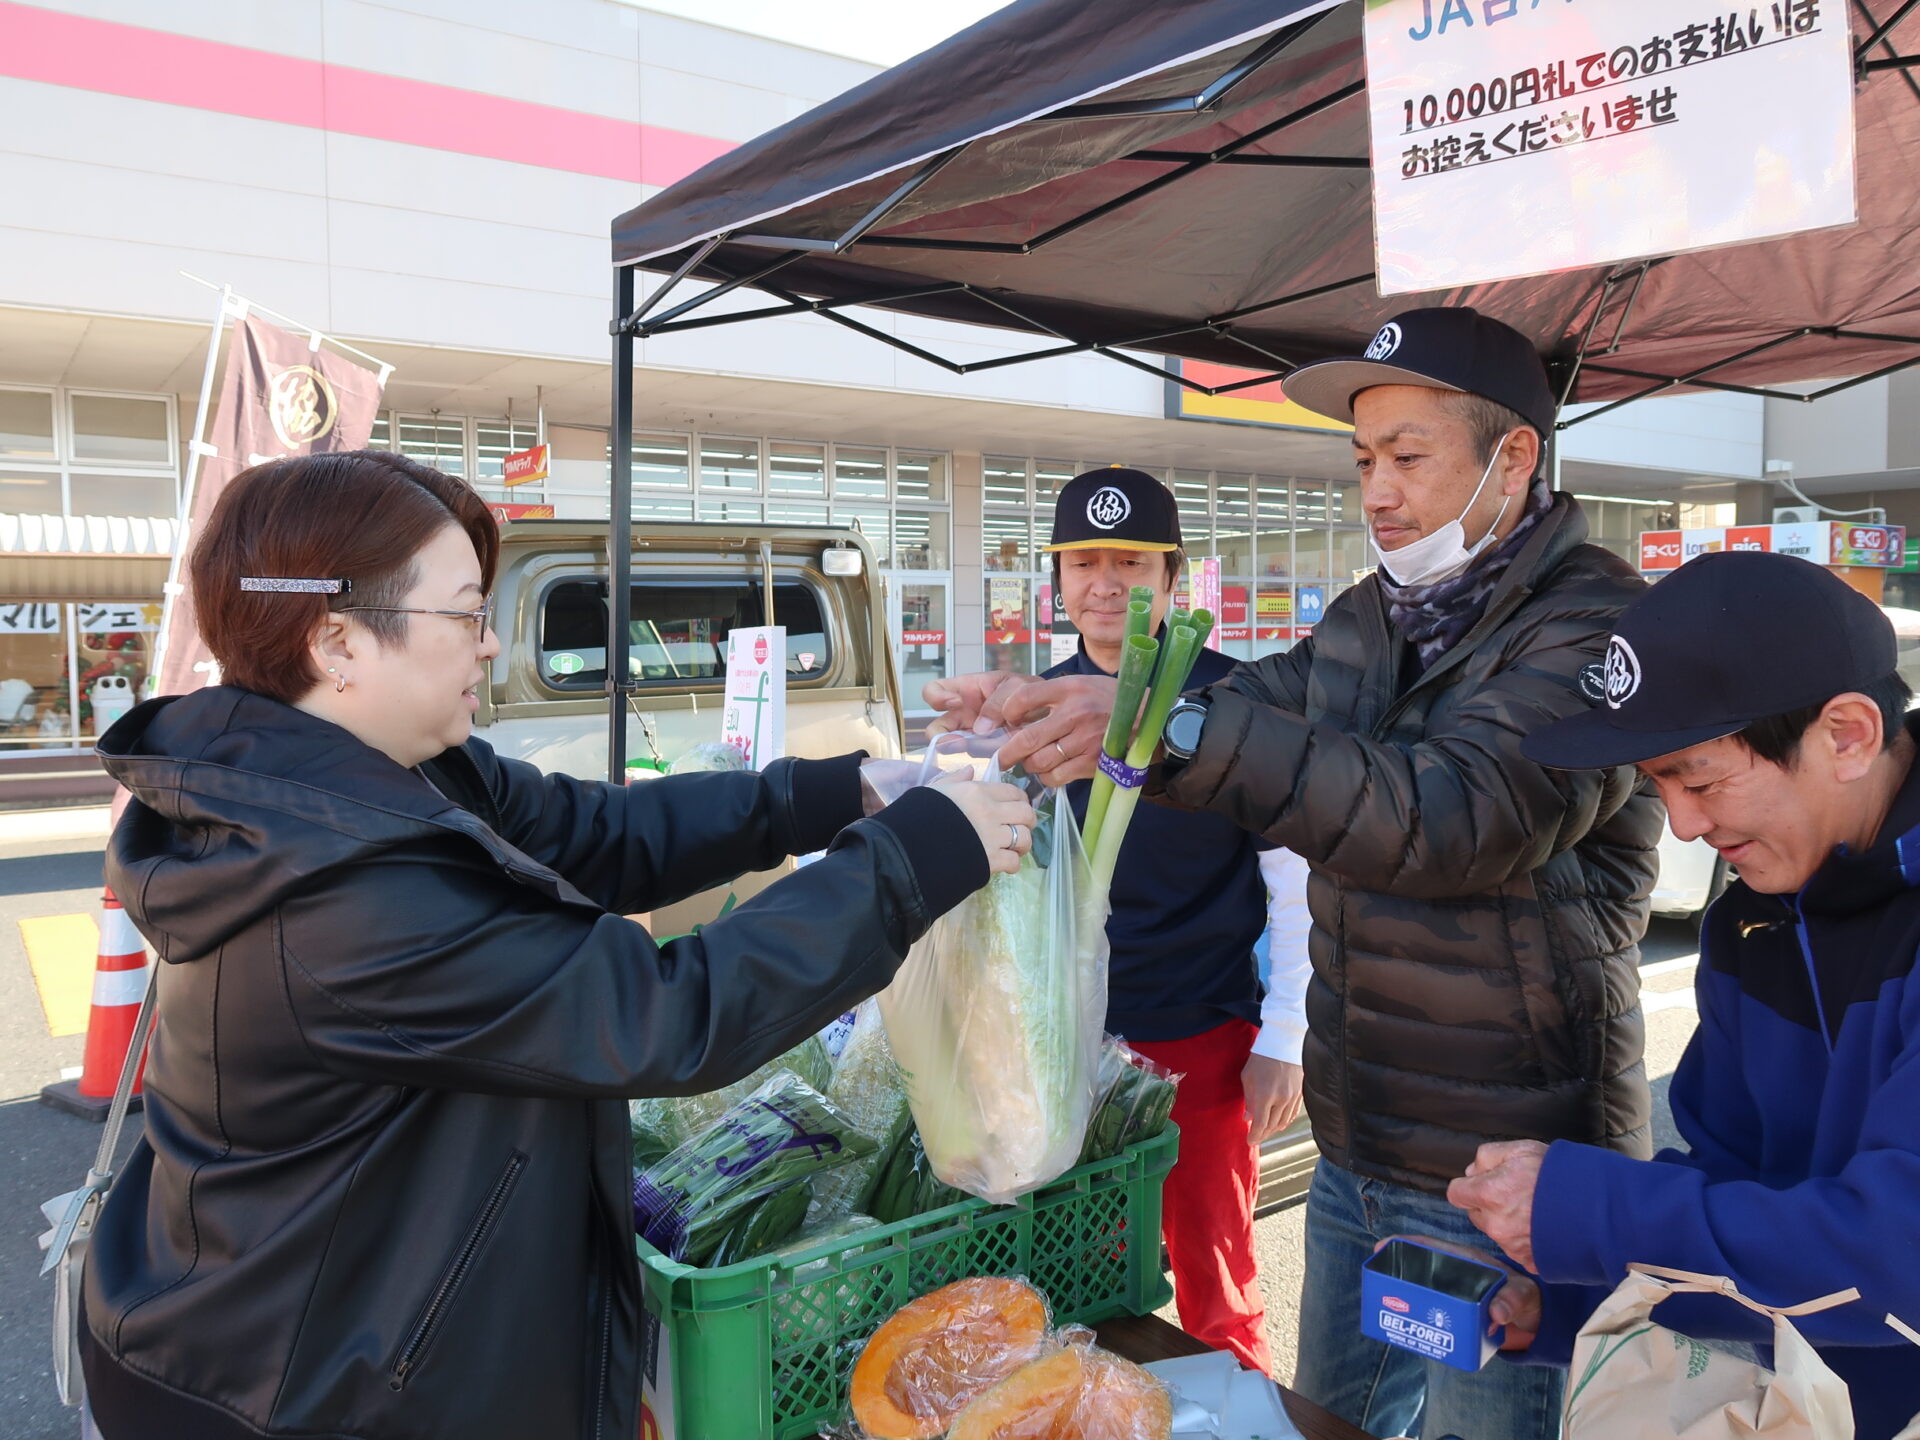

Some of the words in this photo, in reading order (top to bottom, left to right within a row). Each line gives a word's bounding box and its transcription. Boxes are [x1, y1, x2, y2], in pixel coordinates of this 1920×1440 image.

[1403, 0, 1821, 132] 10,000円札でのお支払いは
[1401, 86, 1678, 177] お控えくださいませ
[1383, 1314, 1450, 1347] BEL-FORET
